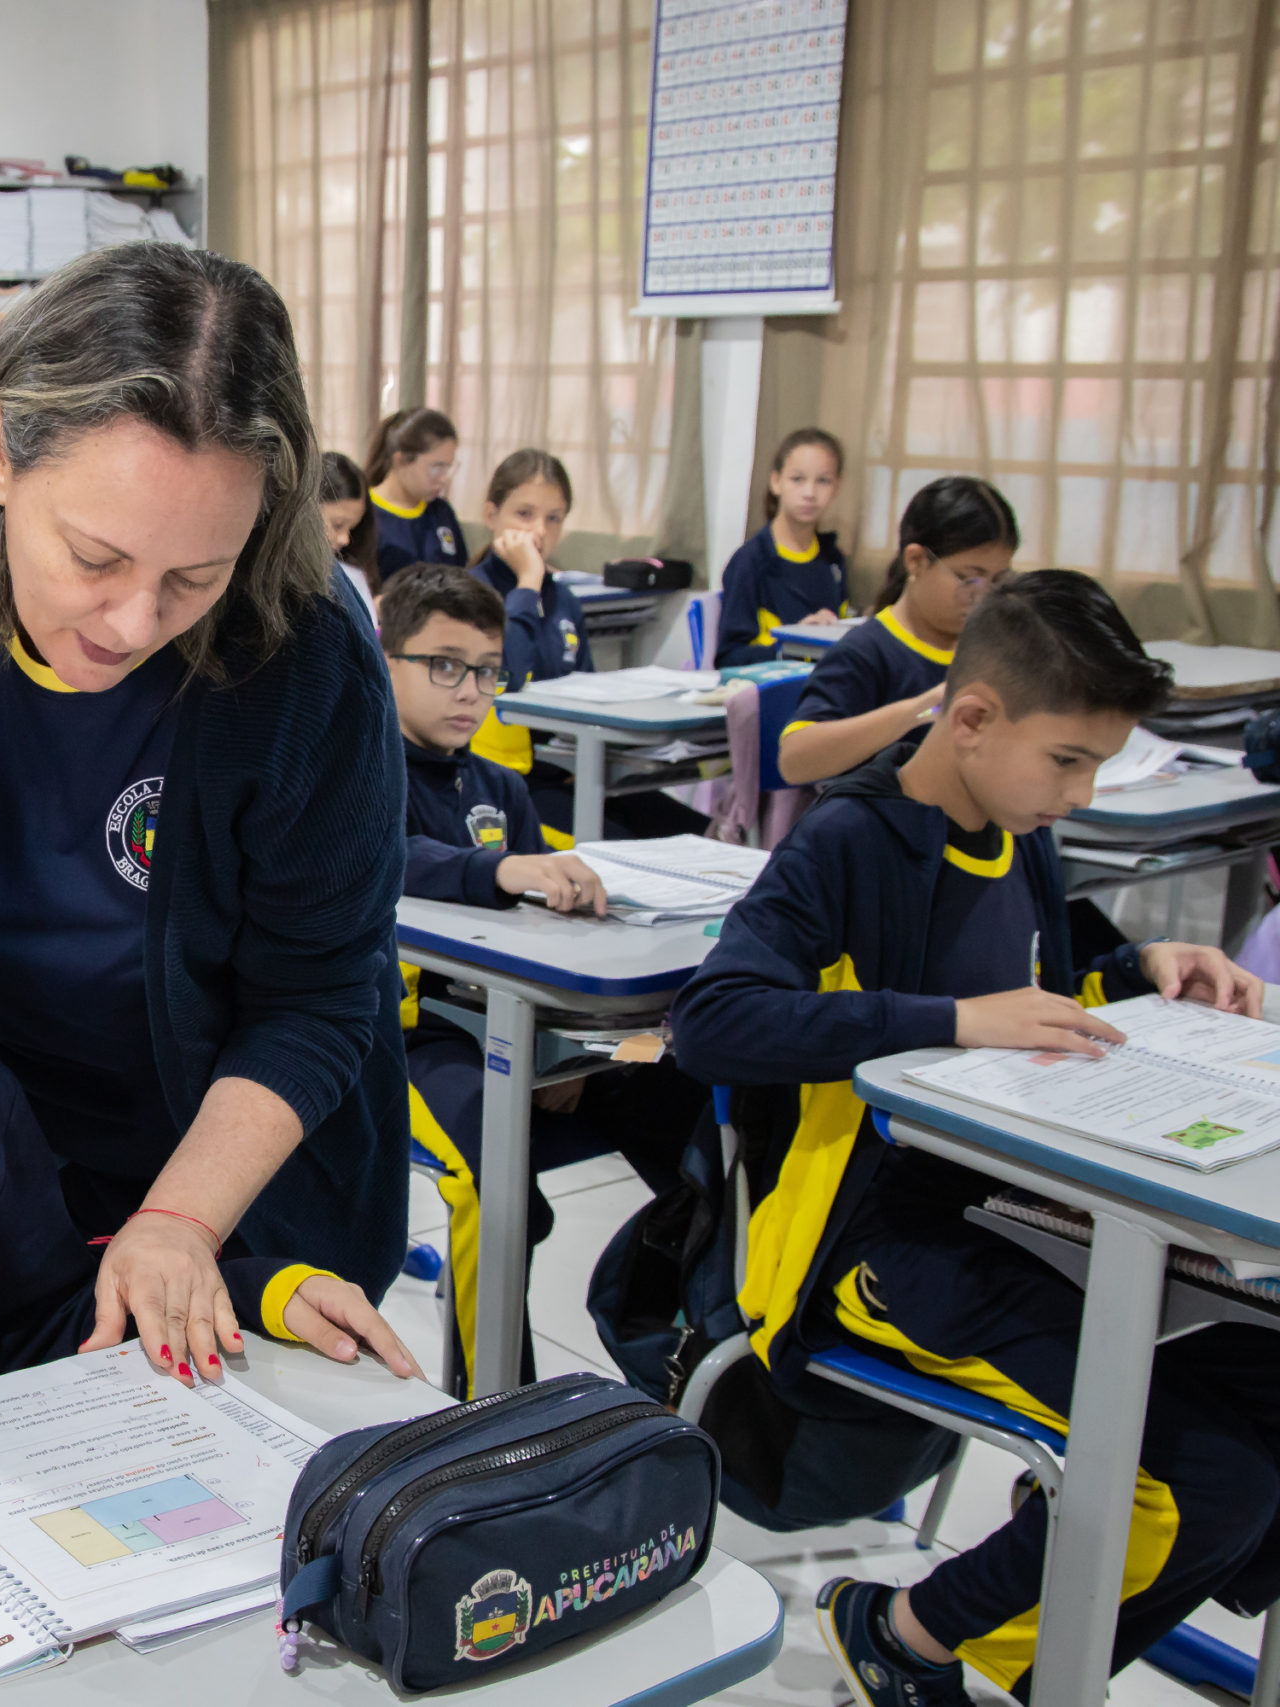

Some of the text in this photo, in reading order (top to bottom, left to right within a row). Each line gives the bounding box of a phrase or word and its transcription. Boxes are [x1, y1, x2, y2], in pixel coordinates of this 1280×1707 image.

[108, 782, 152, 833] ESCOLA
[533, 1525, 696, 1627] APUCARANA
[560, 1523, 676, 1584] PREFEITURA DE
